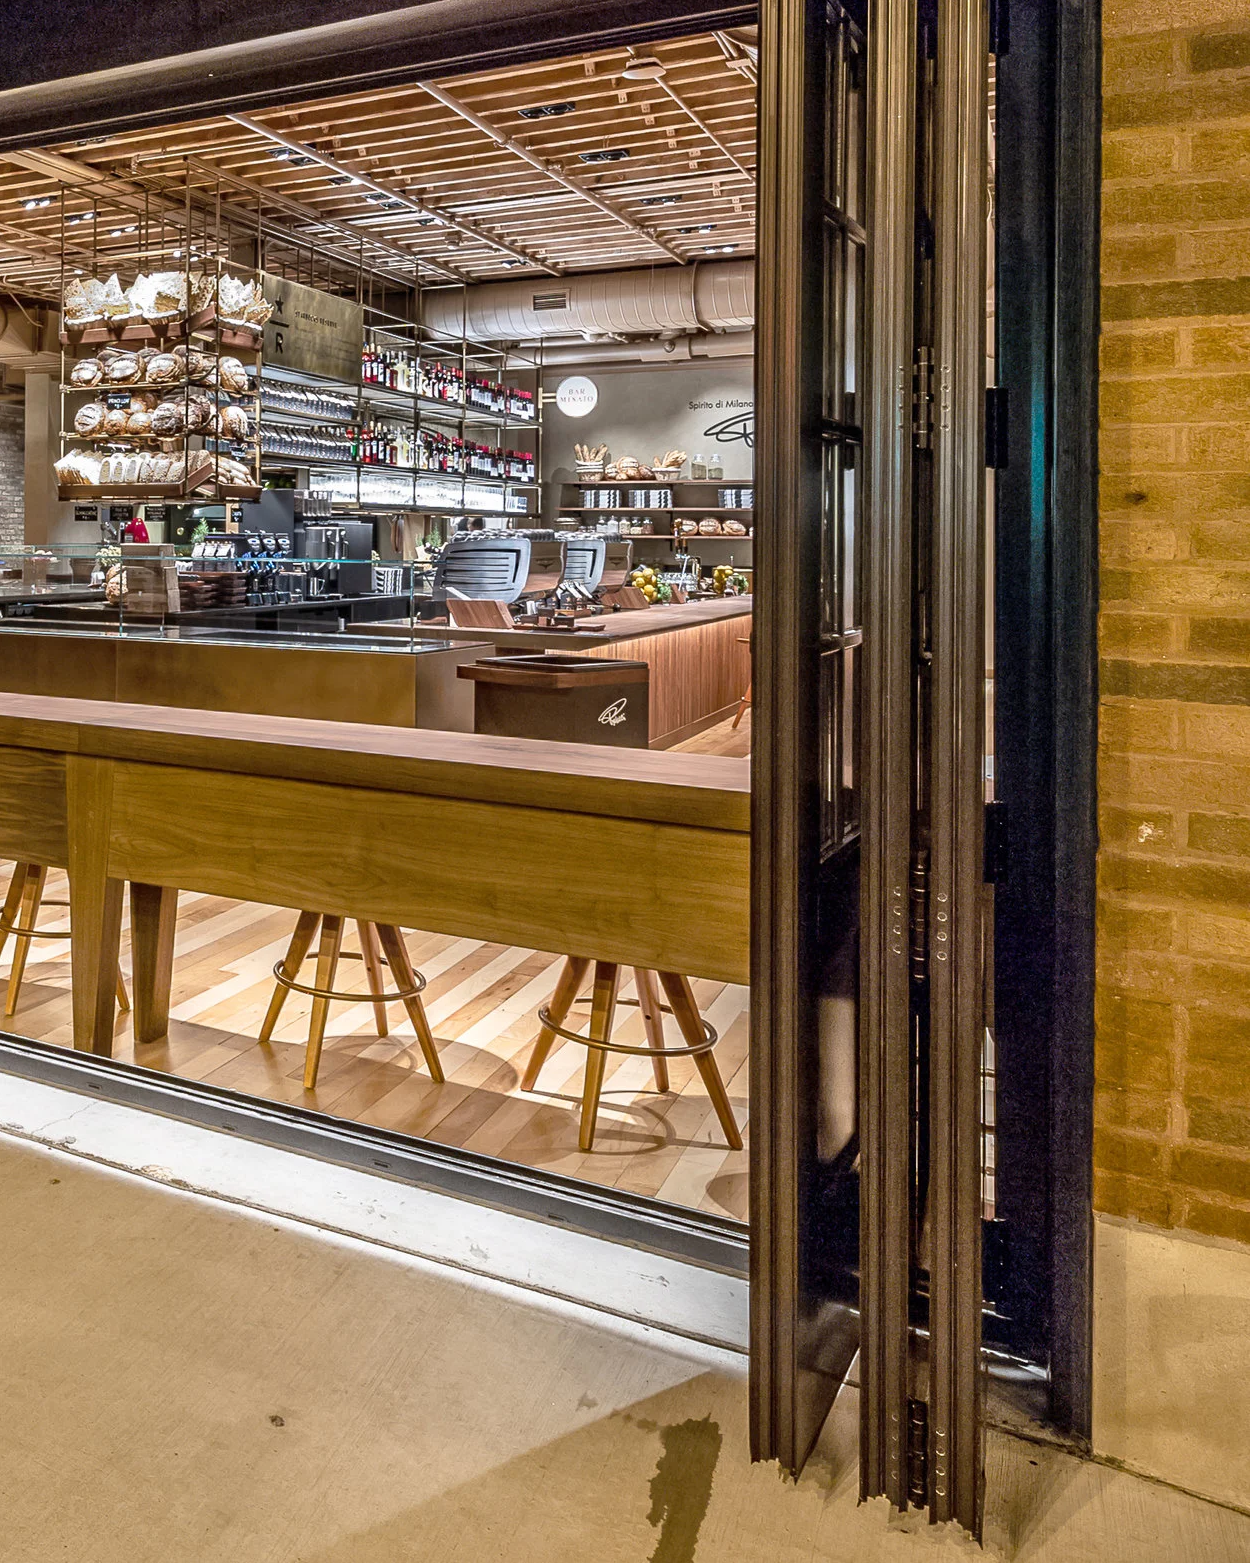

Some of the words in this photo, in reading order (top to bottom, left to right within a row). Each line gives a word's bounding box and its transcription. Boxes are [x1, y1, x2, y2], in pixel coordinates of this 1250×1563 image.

[688, 401, 714, 412] Spirito
[715, 399, 724, 409] di
[725, 399, 754, 408] Milano
